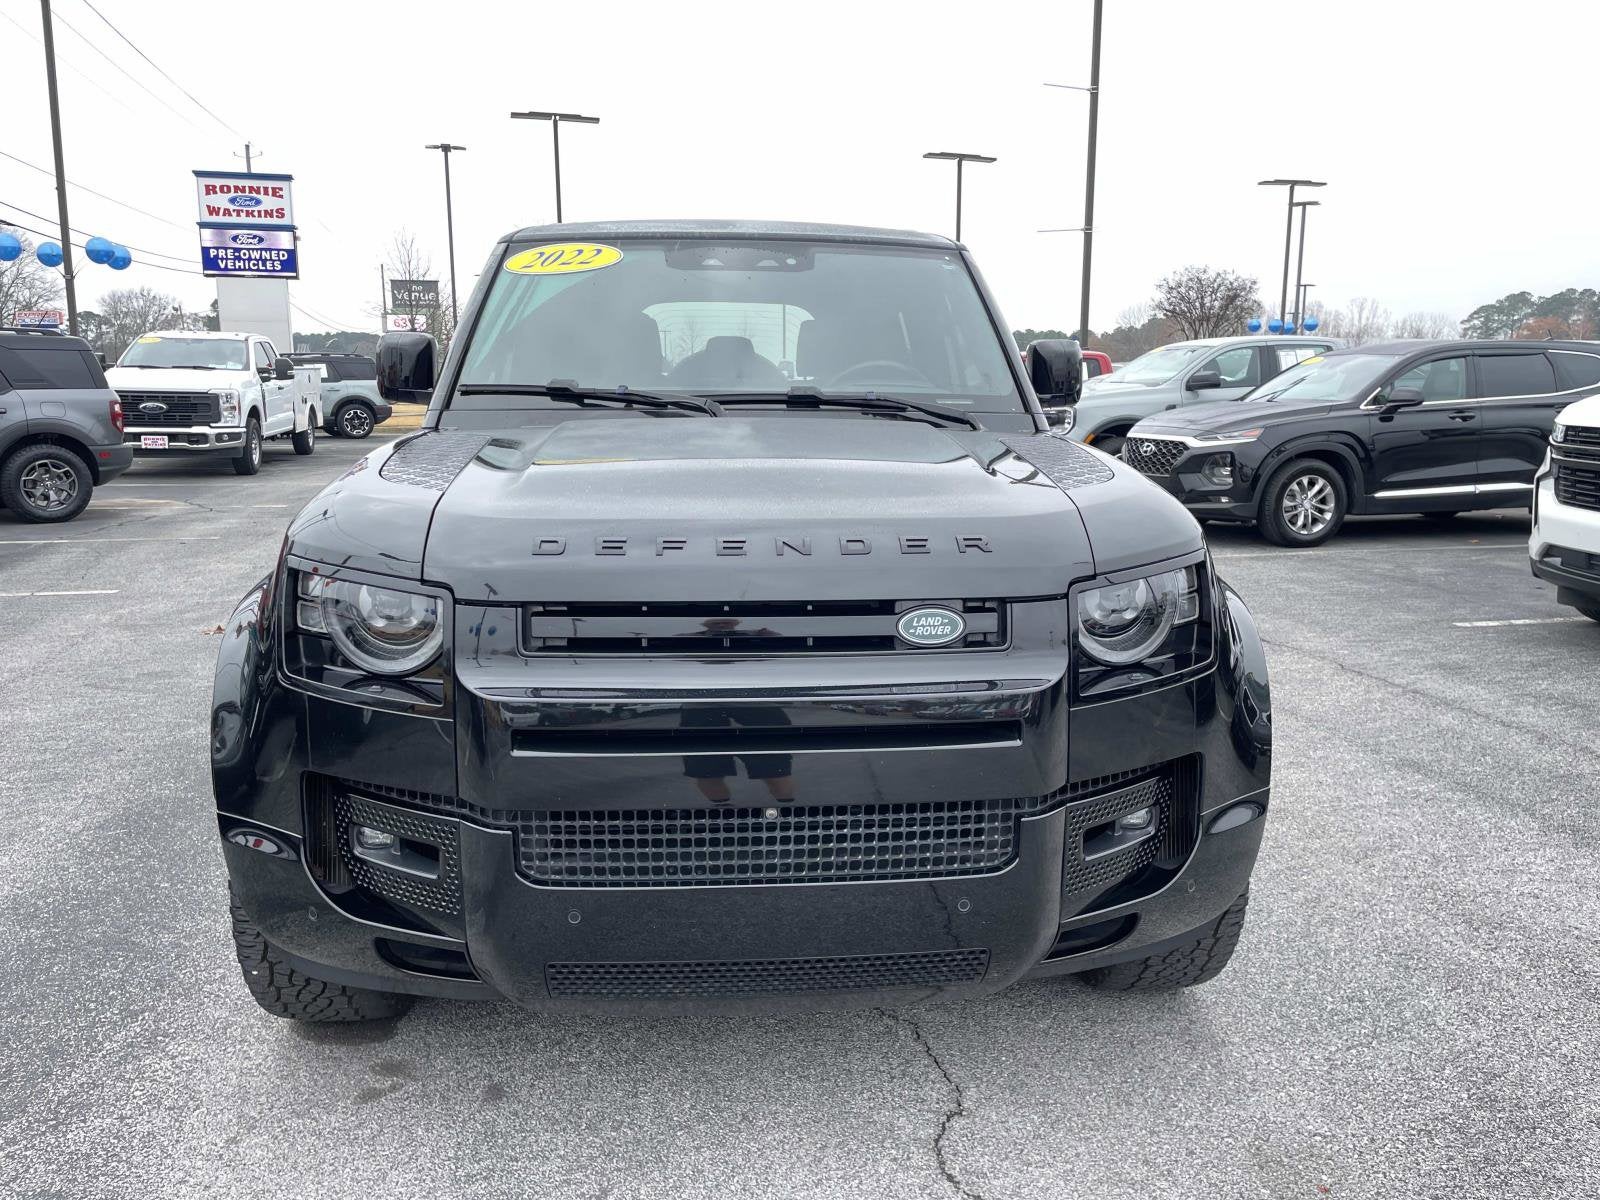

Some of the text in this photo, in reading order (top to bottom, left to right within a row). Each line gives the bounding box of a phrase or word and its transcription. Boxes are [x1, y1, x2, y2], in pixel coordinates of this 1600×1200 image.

[204, 184, 284, 199] RONNIE
[234, 197, 256, 206] Ford
[206, 204, 286, 219] WATKINS
[236, 235, 260, 246] Ford
[209, 248, 288, 260] PRE-OWNED
[519, 248, 603, 270] 2022
[217, 259, 282, 271] VEHICLES
[530, 535, 994, 557] DEFENDER
